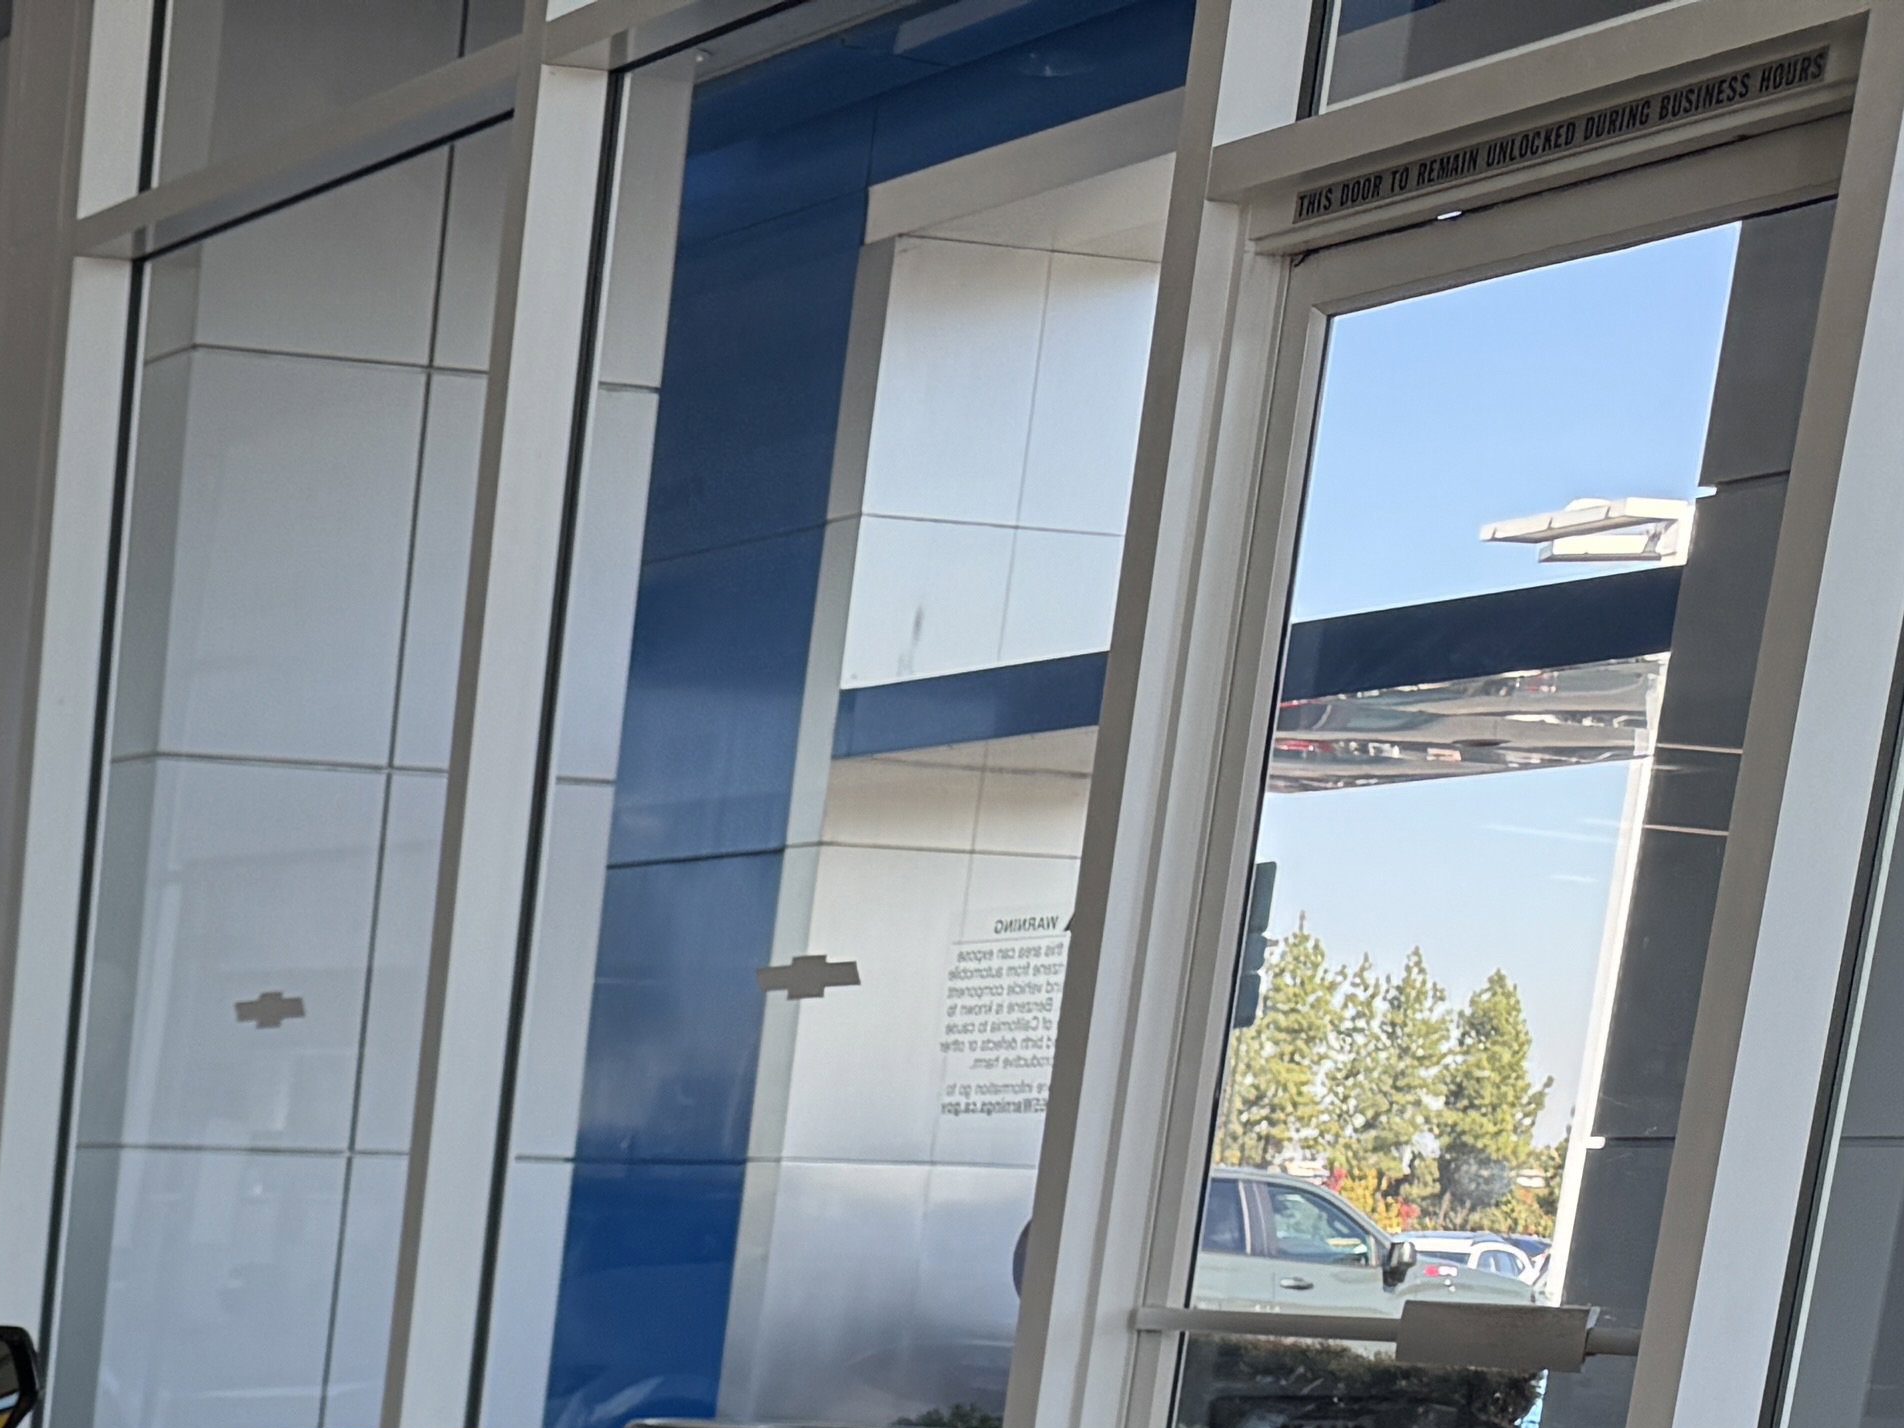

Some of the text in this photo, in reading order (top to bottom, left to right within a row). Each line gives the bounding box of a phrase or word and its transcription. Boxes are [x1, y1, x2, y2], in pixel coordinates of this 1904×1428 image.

[1297, 51, 1826, 218] THIS DOOR TO REMAIN UNLOCKED DURING BUSINESS HOURS
